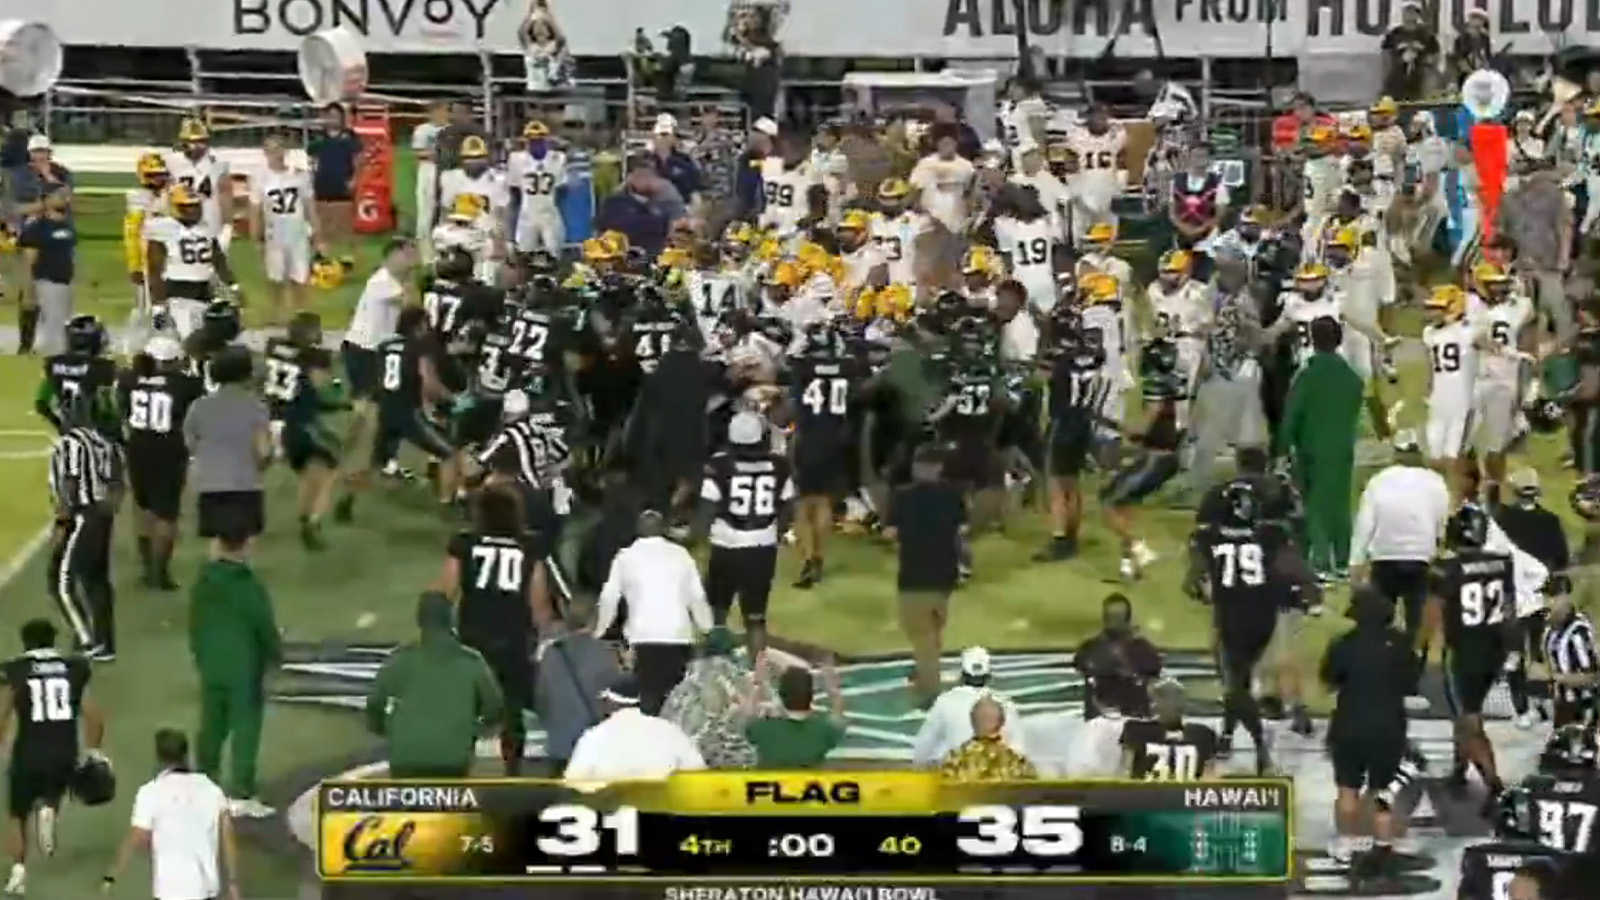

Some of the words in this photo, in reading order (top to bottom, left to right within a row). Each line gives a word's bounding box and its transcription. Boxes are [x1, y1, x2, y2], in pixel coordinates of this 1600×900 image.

[943, 0, 1158, 37] ALOHA
[1175, 0, 1288, 23] FROM
[267, 187, 298, 214] 37
[526, 173, 555, 195] 33
[179, 237, 214, 264] 62
[1016, 238, 1048, 266] 19
[383, 353, 400, 391] 8
[1433, 343, 1460, 373] 19
[129, 389, 173, 434] 60
[802, 378, 848, 416] 40
[729, 475, 775, 516] 56
[471, 545, 525, 592] 70
[1210, 542, 1266, 588] 79
[1460, 579, 1504, 626] 92
[26, 677, 72, 722] 10
[1537, 799, 1599, 853] 97
